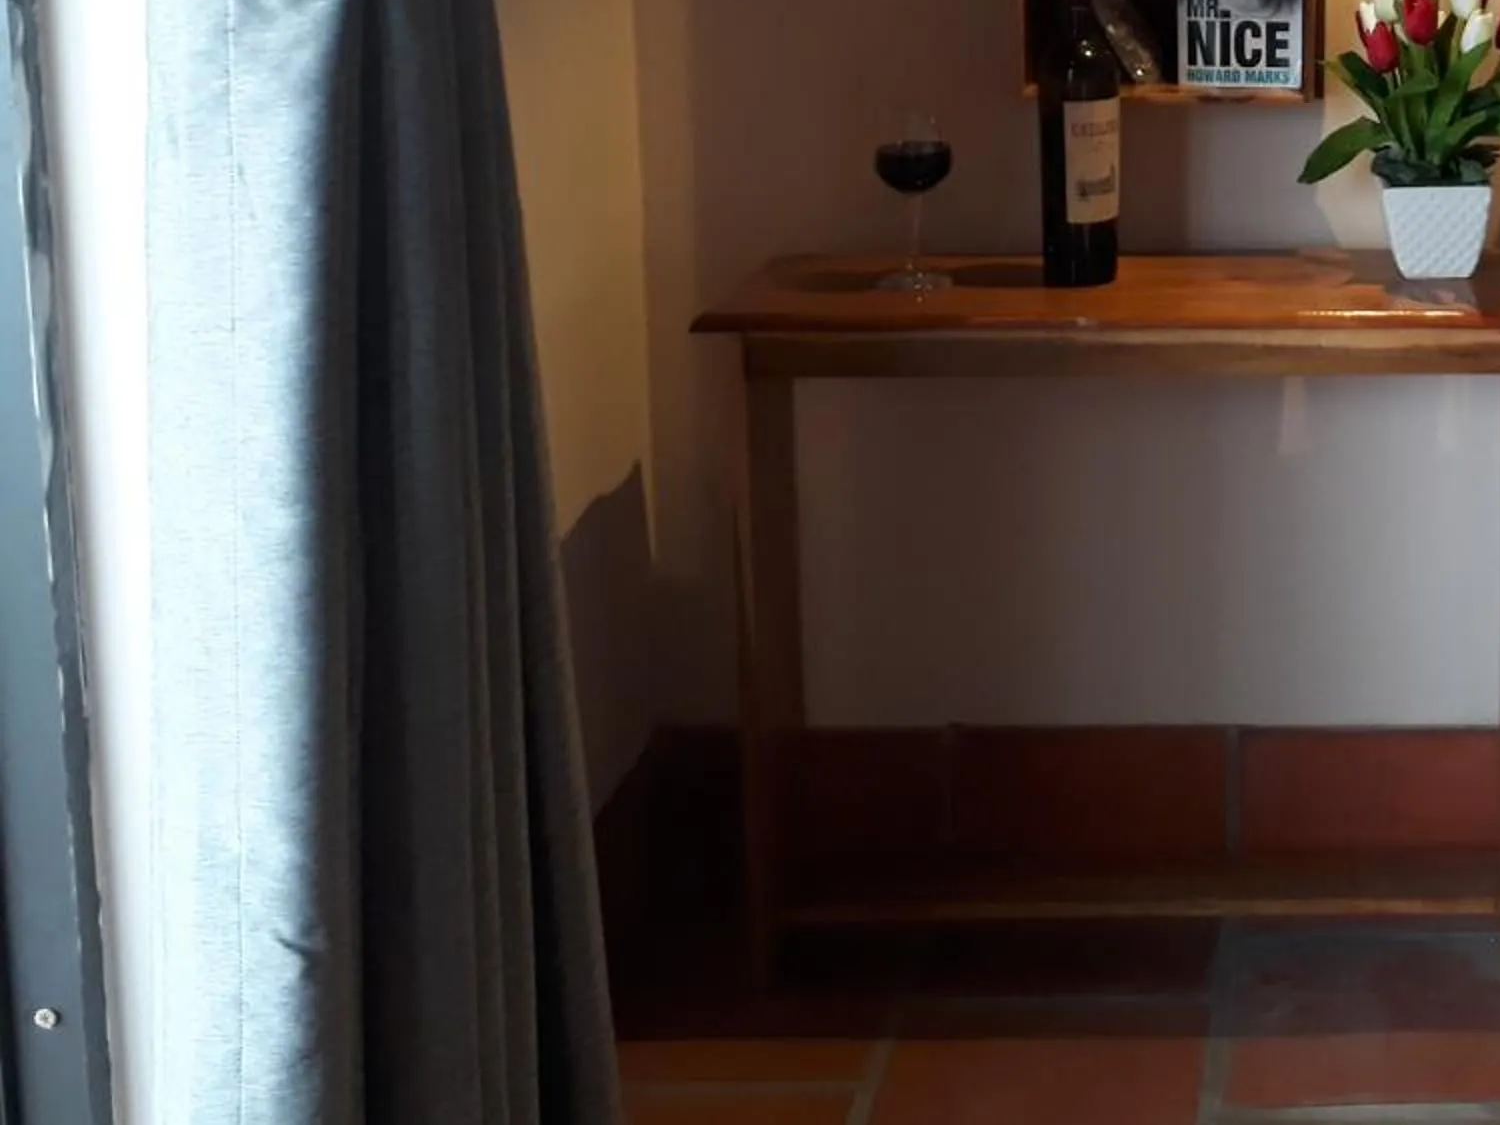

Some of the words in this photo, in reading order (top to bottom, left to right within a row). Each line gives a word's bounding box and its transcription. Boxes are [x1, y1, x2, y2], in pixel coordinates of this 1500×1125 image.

[1187, 20, 1291, 68] NICE
[1187, 69, 1241, 83] HOWARD
[1244, 69, 1290, 83] MARKS
